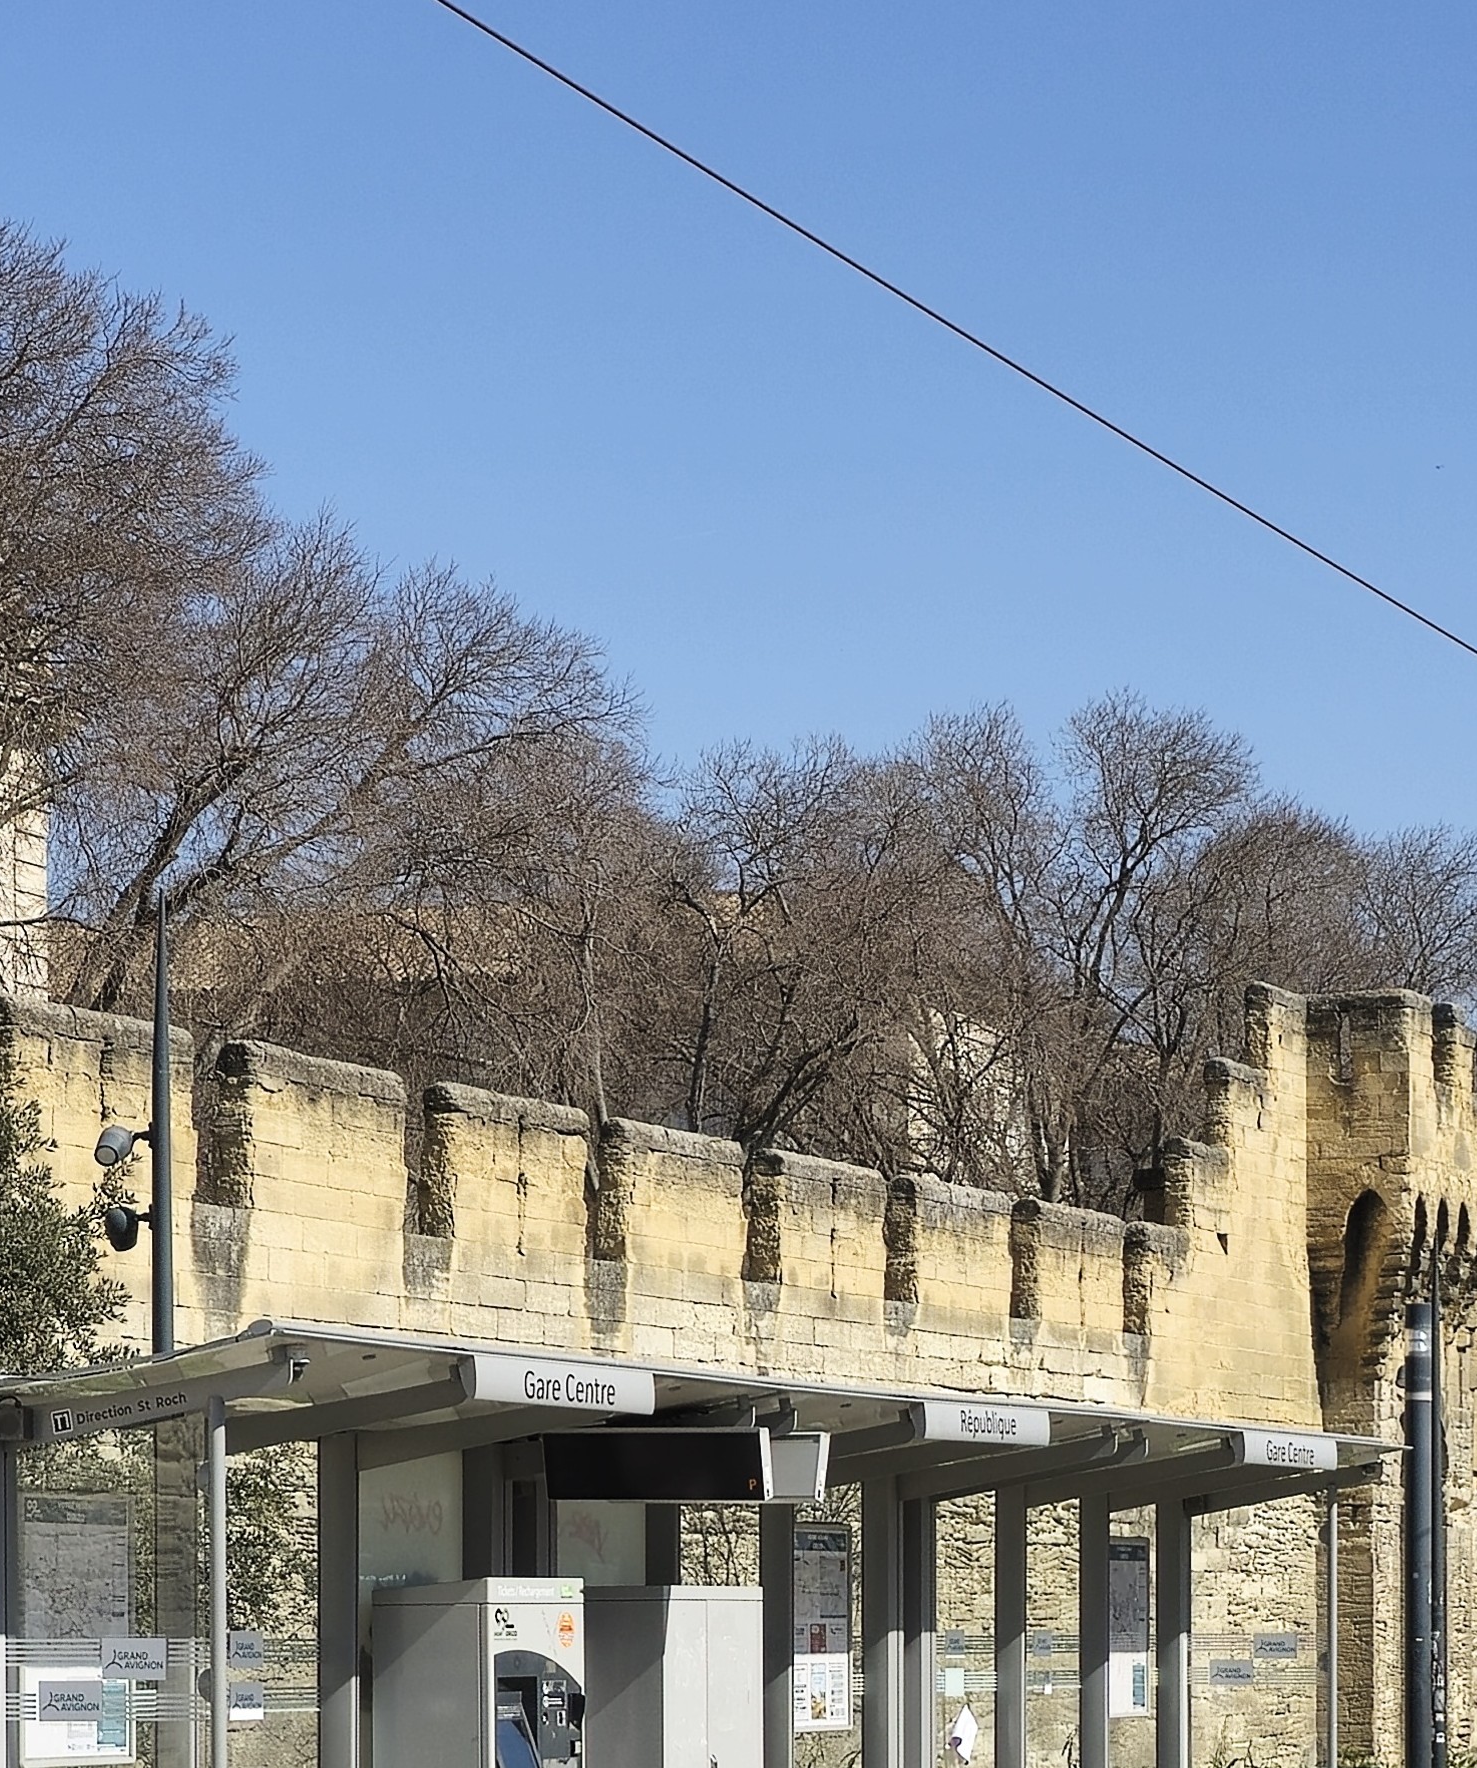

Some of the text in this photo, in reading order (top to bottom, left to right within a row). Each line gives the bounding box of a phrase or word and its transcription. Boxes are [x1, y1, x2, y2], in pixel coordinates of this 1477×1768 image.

[524, 1370, 616, 1406] Gare Centre
[76, 1405, 132, 1425] Direction
[137, 1400, 151, 1412] St
[156, 1392, 187, 1409] Roch
[960, 1409, 1017, 1440] République
[1266, 1440, 1314, 1465] Gare Centre
[117, 1651, 148, 1660] GRAND
[124, 1661, 163, 1669] AVIGNON
[54, 1693, 84, 1702] GRAND
[61, 1702, 100, 1711] AVIGNON
